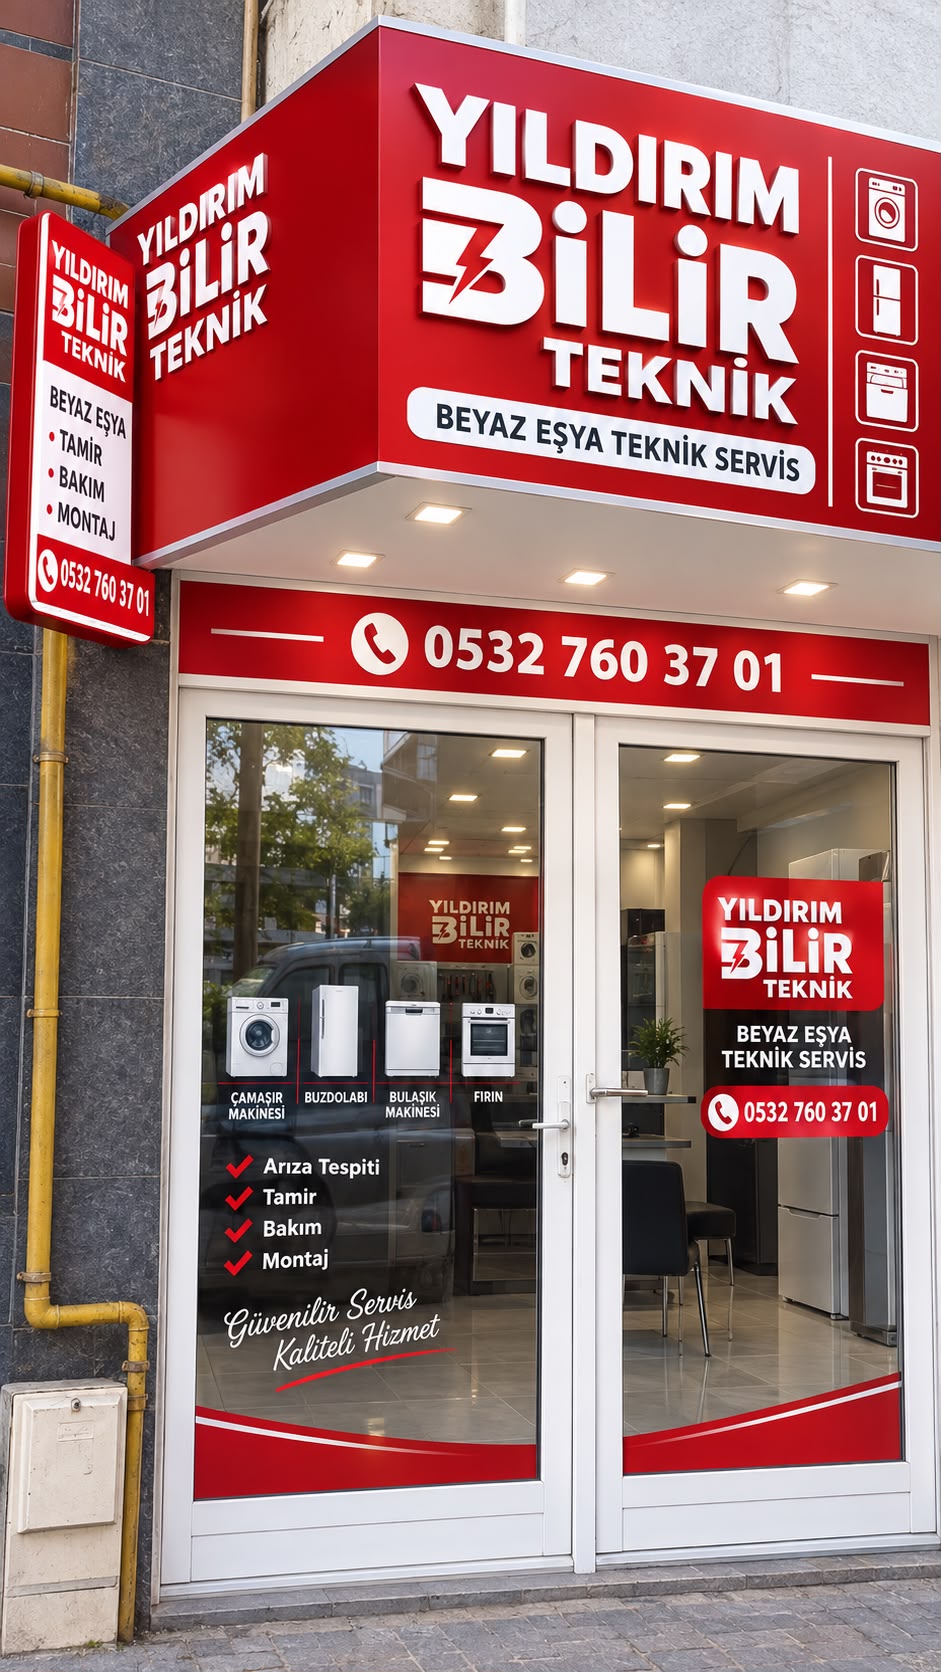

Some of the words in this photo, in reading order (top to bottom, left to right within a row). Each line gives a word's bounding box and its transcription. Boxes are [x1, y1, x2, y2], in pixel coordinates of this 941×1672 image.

[414, 82, 799, 235] YILDIRIM
[137, 152, 267, 267] YILDIRIM
[51, 239, 129, 310] YILDIRIM
[150, 283, 269, 382] TEKNİK
[61, 330, 126, 383] TEKNİK
[541, 336, 799, 425] TEKNİK
[50, 385, 92, 424] BEYAZ
[96, 406, 127, 440] EŞYA
[59, 428, 103, 467] TAMİR
[436, 403, 526, 441] BEYAZ
[536, 418, 604, 455] EŞYA
[611, 431, 707, 469] TEKNİK
[716, 446, 800, 483] SERVİS
[59, 465, 105, 503] BAKIM
[57, 501, 116, 542] MONTAJ
[60, 558, 92, 595] 0532
[94, 569, 117, 601] 760
[119, 580, 135, 610] 37
[136, 586, 150, 617] 01
[424, 624, 545, 676] 0532
[560, 635, 649, 683] 760
[663, 643, 719, 688] 37
[733, 649, 783, 693] 01
[428, 899, 511, 915] YILDIRIM
[717, 896, 843, 925] YILDIRIM
[458, 936, 510, 950] TEKNİK
[762, 975, 853, 999] TEKNİK
[736, 1025, 799, 1044] BEYAZ
[804, 1025, 852, 1048] EŞYA
[721, 1046, 794, 1069] TEKNİK
[798, 1046, 867, 1069] SERVİS
[230, 1091, 283, 1107] ÇAMAŞIR
[304, 1091, 368, 1103] BUZDOLABI
[389, 1091, 437, 1105] BULAŞIK
[474, 1091, 503, 1103] FIRIN
[228, 1104, 285, 1120] MAKİNESİ
[385, 1103, 440, 1118] MAKİNESİ
[743, 1101, 789, 1123] 0532
[793, 1101, 826, 1123] 760
[831, 1101, 853, 1123] 37
[857, 1101, 878, 1122] 01
[263, 1157, 312, 1175] Arıza
[318, 1158, 380, 1179] Tespiti
[263, 1188, 317, 1206] Tamir
[263, 1219, 322, 1238] Bakım
[262, 1248, 329, 1270] Montaj
[223, 1296, 340, 1348] Güvenilir
[346, 1288, 417, 1320] Servis
[273, 1327, 356, 1372] Kaliteli
[361, 1313, 441, 1353] Hizmet
